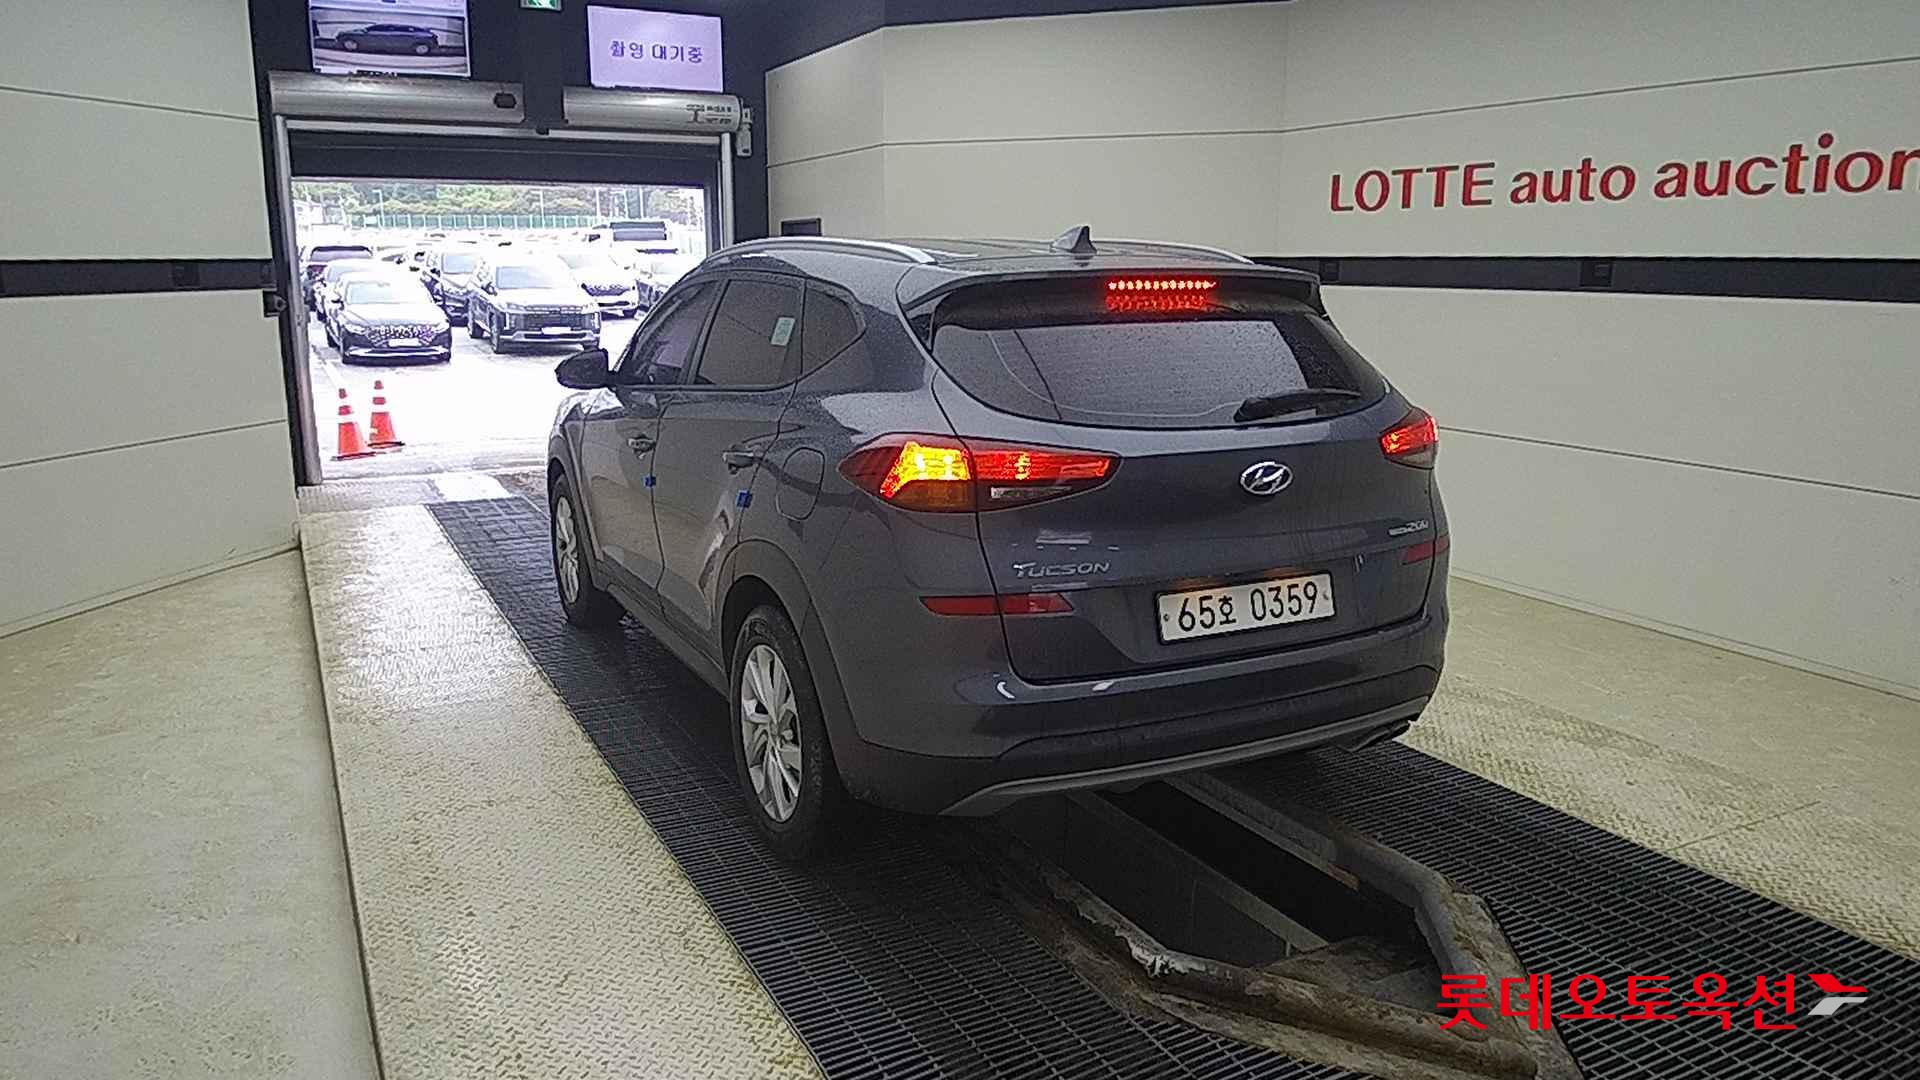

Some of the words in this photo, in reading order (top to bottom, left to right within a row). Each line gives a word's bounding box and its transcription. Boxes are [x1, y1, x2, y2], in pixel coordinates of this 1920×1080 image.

[610, 40, 644, 60] 촬영
[651, 43, 703, 63] 대기중
[1330, 161, 1496, 212] LOTTE
[1509, 157, 1637, 204] auto
[1012, 561, 1111, 578] TUCSON
[1178, 595, 1237, 632] 65호
[1250, 581, 1318, 621] 0359
